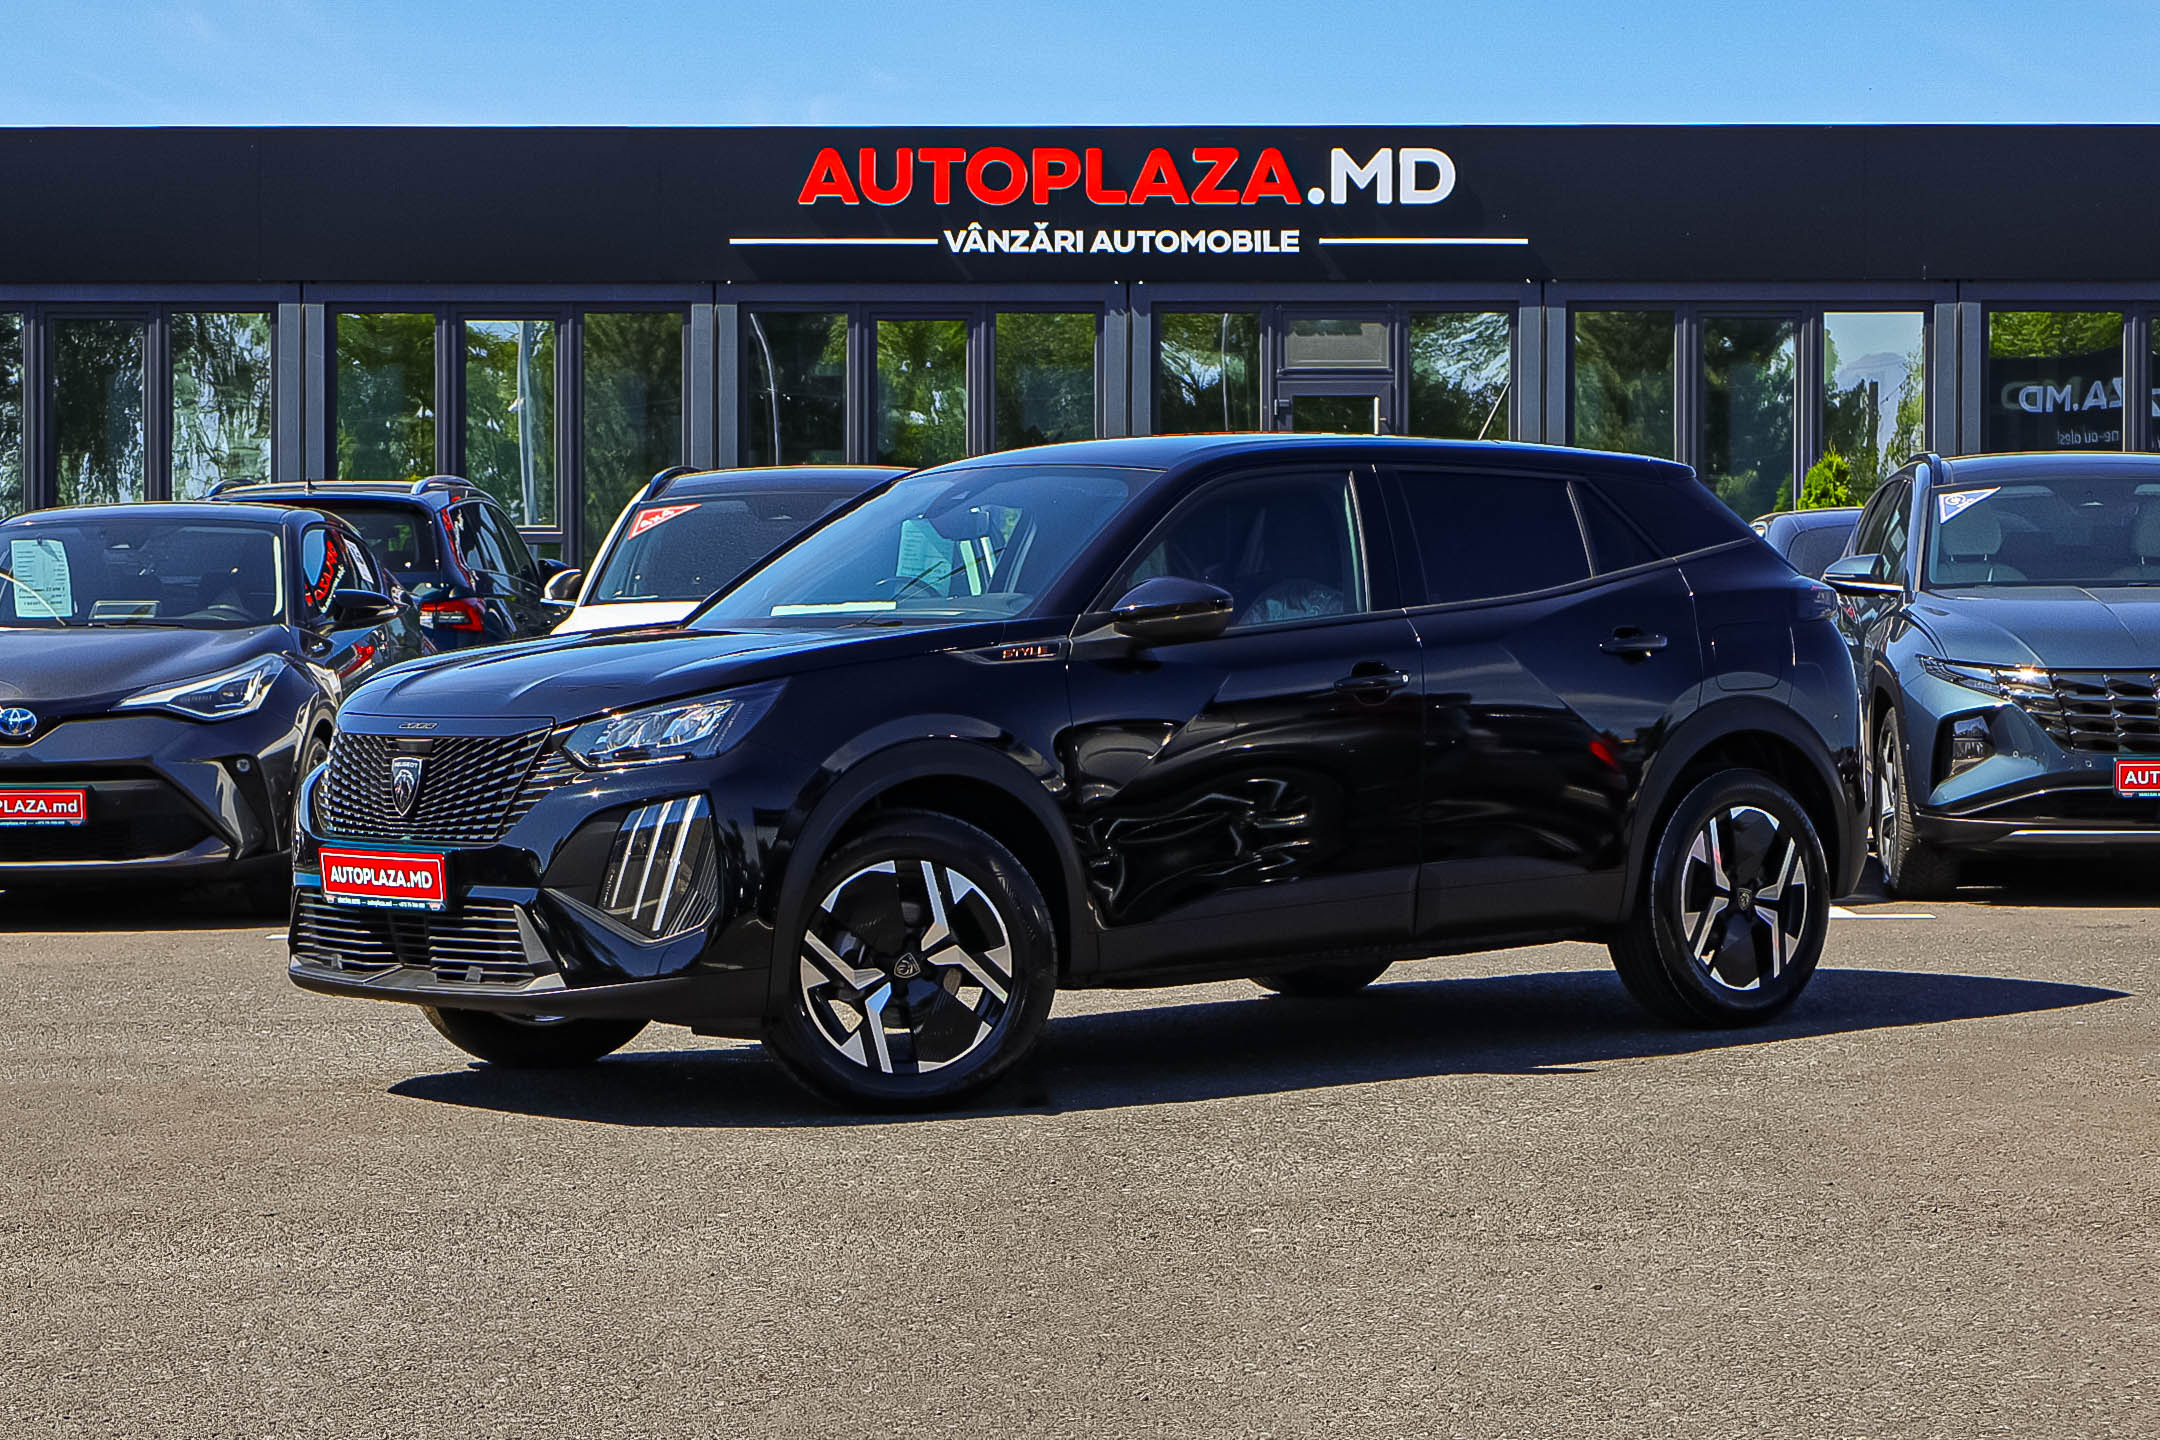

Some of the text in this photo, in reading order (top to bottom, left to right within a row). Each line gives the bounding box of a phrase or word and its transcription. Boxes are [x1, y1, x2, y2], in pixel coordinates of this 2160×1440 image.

[797, 146, 1456, 207] AUTOPLAZA.MD
[943, 221, 1300, 254] VÂNZĂRI AUTOMOBILE
[330, 865, 433, 889] AUTOPLAZA.MD
